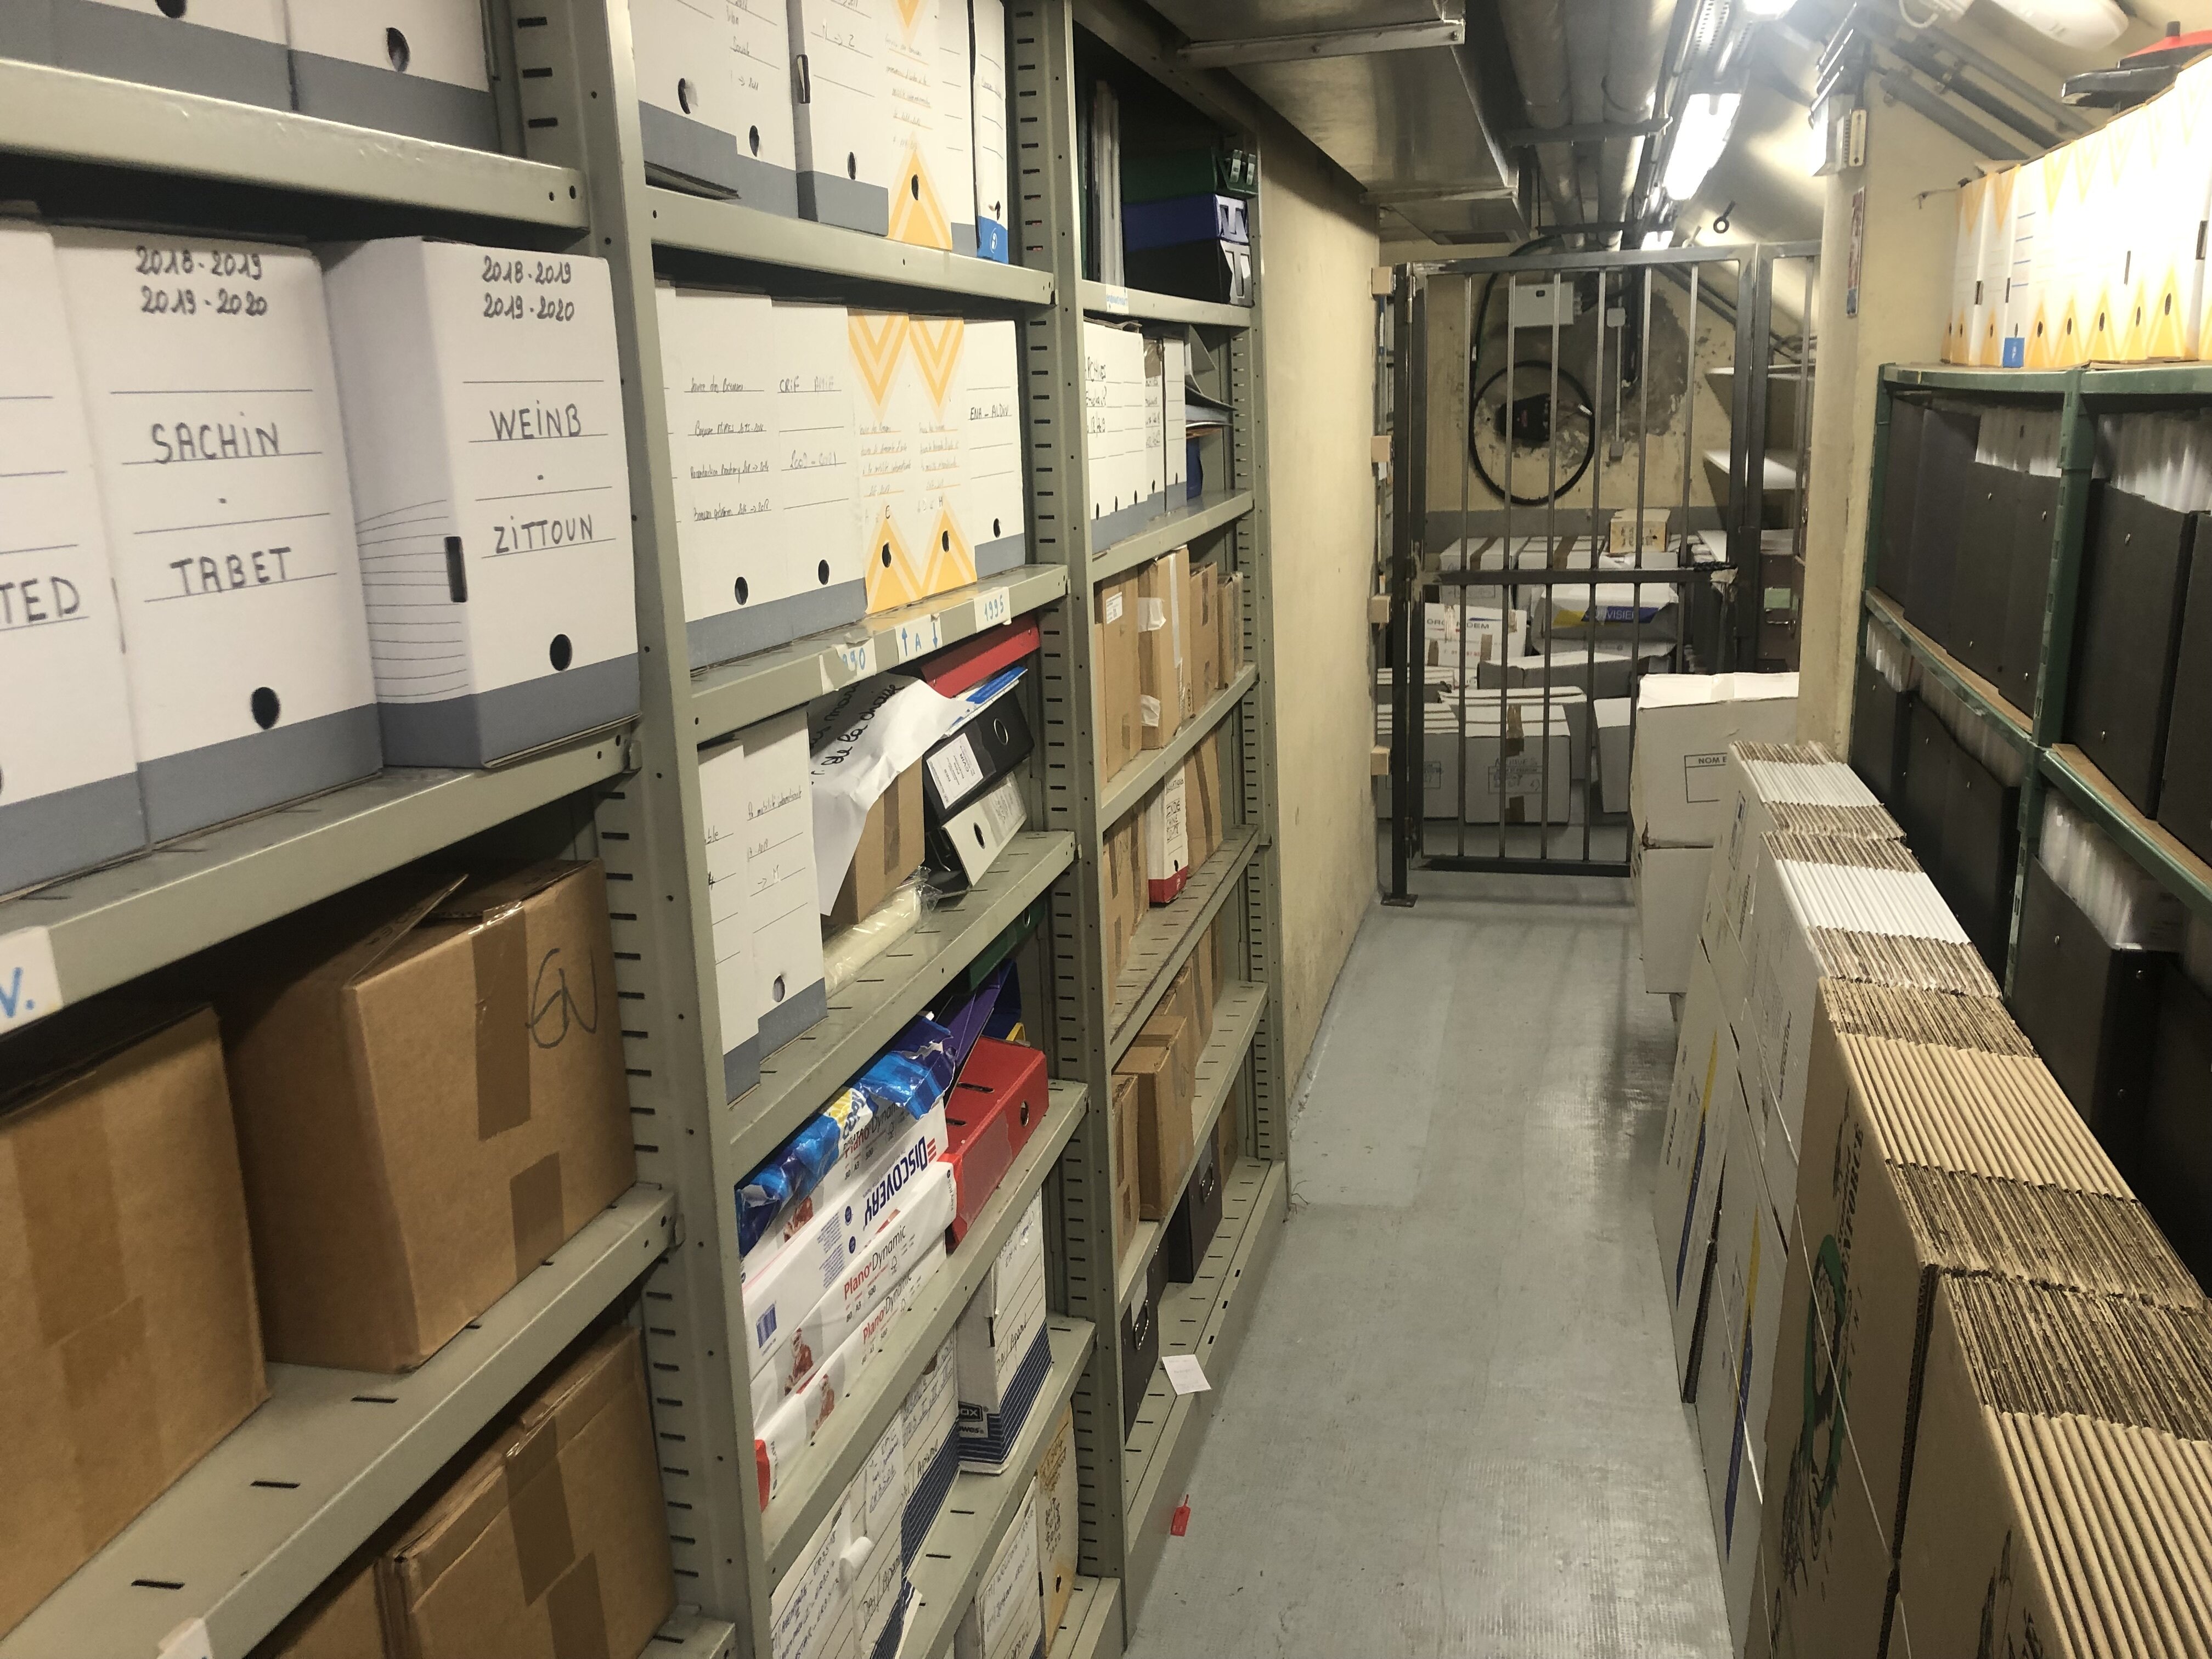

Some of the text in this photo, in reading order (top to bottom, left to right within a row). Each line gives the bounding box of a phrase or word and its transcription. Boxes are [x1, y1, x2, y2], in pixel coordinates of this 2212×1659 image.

[136, 245, 263, 281] 2018-2019
[482, 255, 572, 285] 2018-2019
[140, 285, 268, 317] 2019-2020
[483, 292, 575, 321] 2019-2020
[170, 546, 291, 596] TABET
[984, 595, 1004, 622] 1995
[915, 633, 922, 652] A
[1698, 755, 1720, 764] NOM
[865, 1136, 928, 1227] DISCOVERY
[844, 1263, 871, 1300] Plano
[872, 1224, 906, 1272] Dynamic
[863, 1308, 884, 1345] Plano
